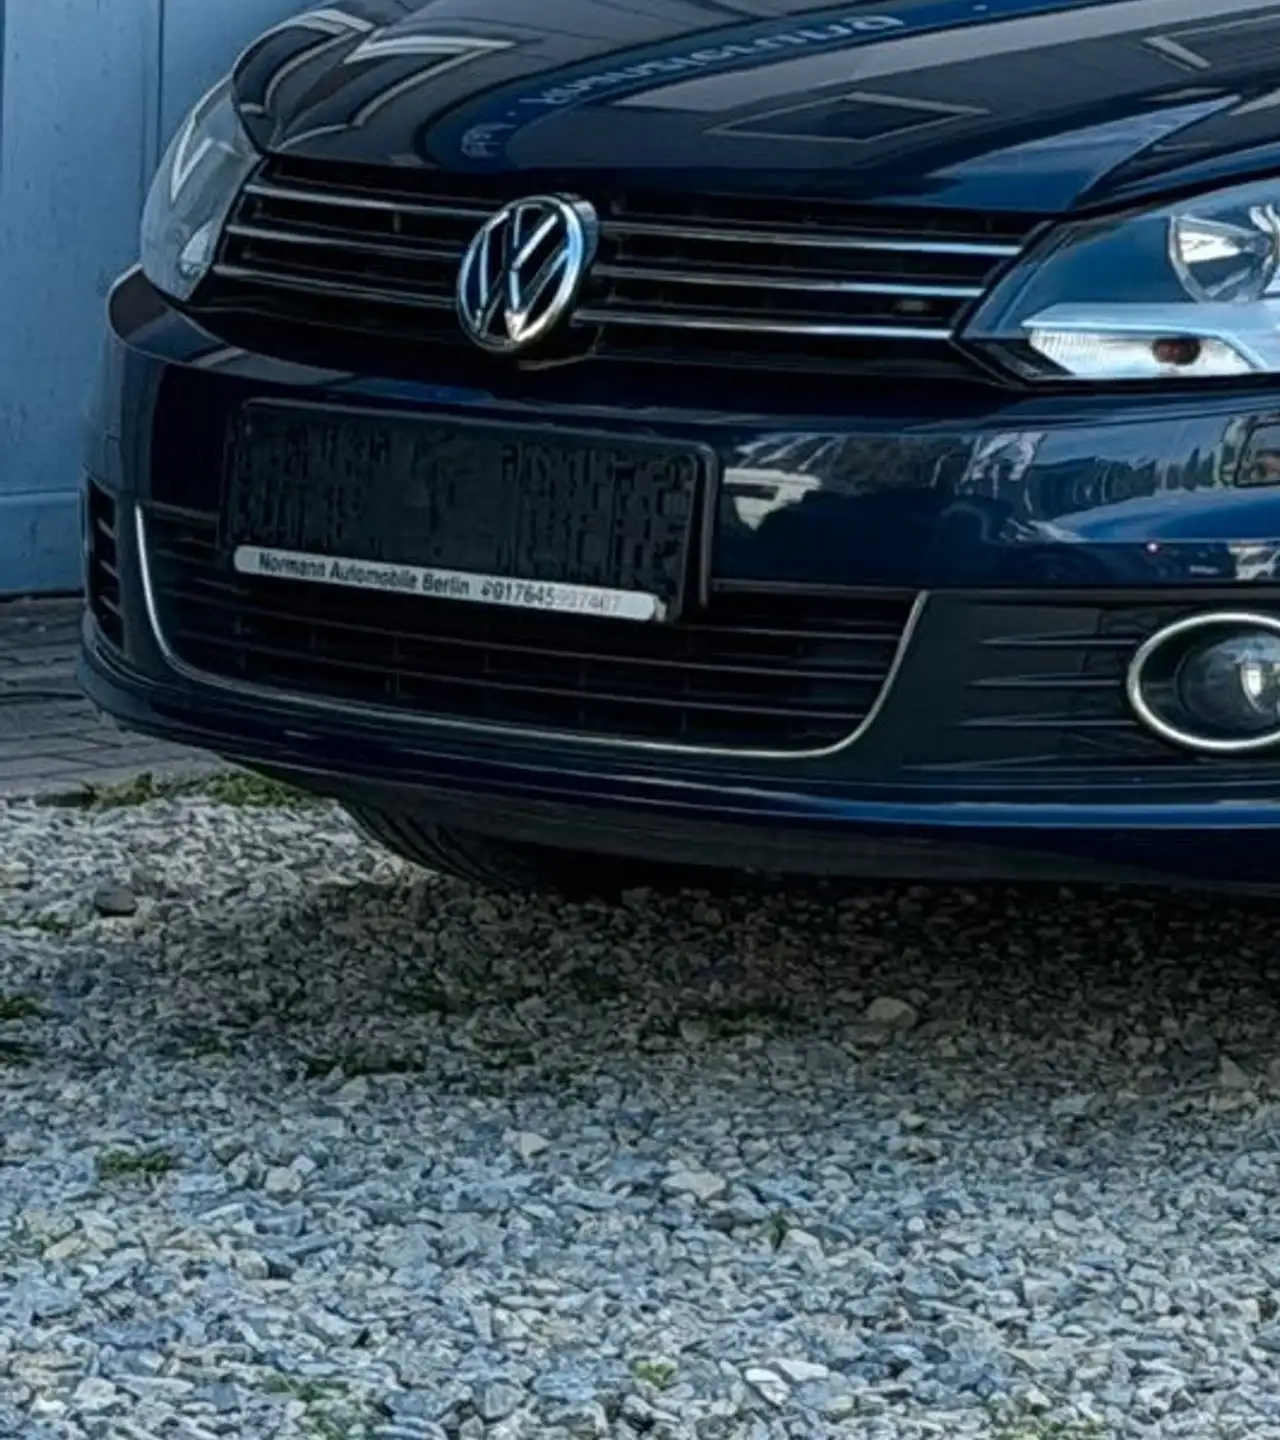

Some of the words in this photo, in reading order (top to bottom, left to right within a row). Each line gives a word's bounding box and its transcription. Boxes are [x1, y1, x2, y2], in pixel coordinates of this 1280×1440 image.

[258, 551, 326, 578] Normann
[329, 561, 418, 589] Automobile
[422, 571, 470, 596] Berlin
